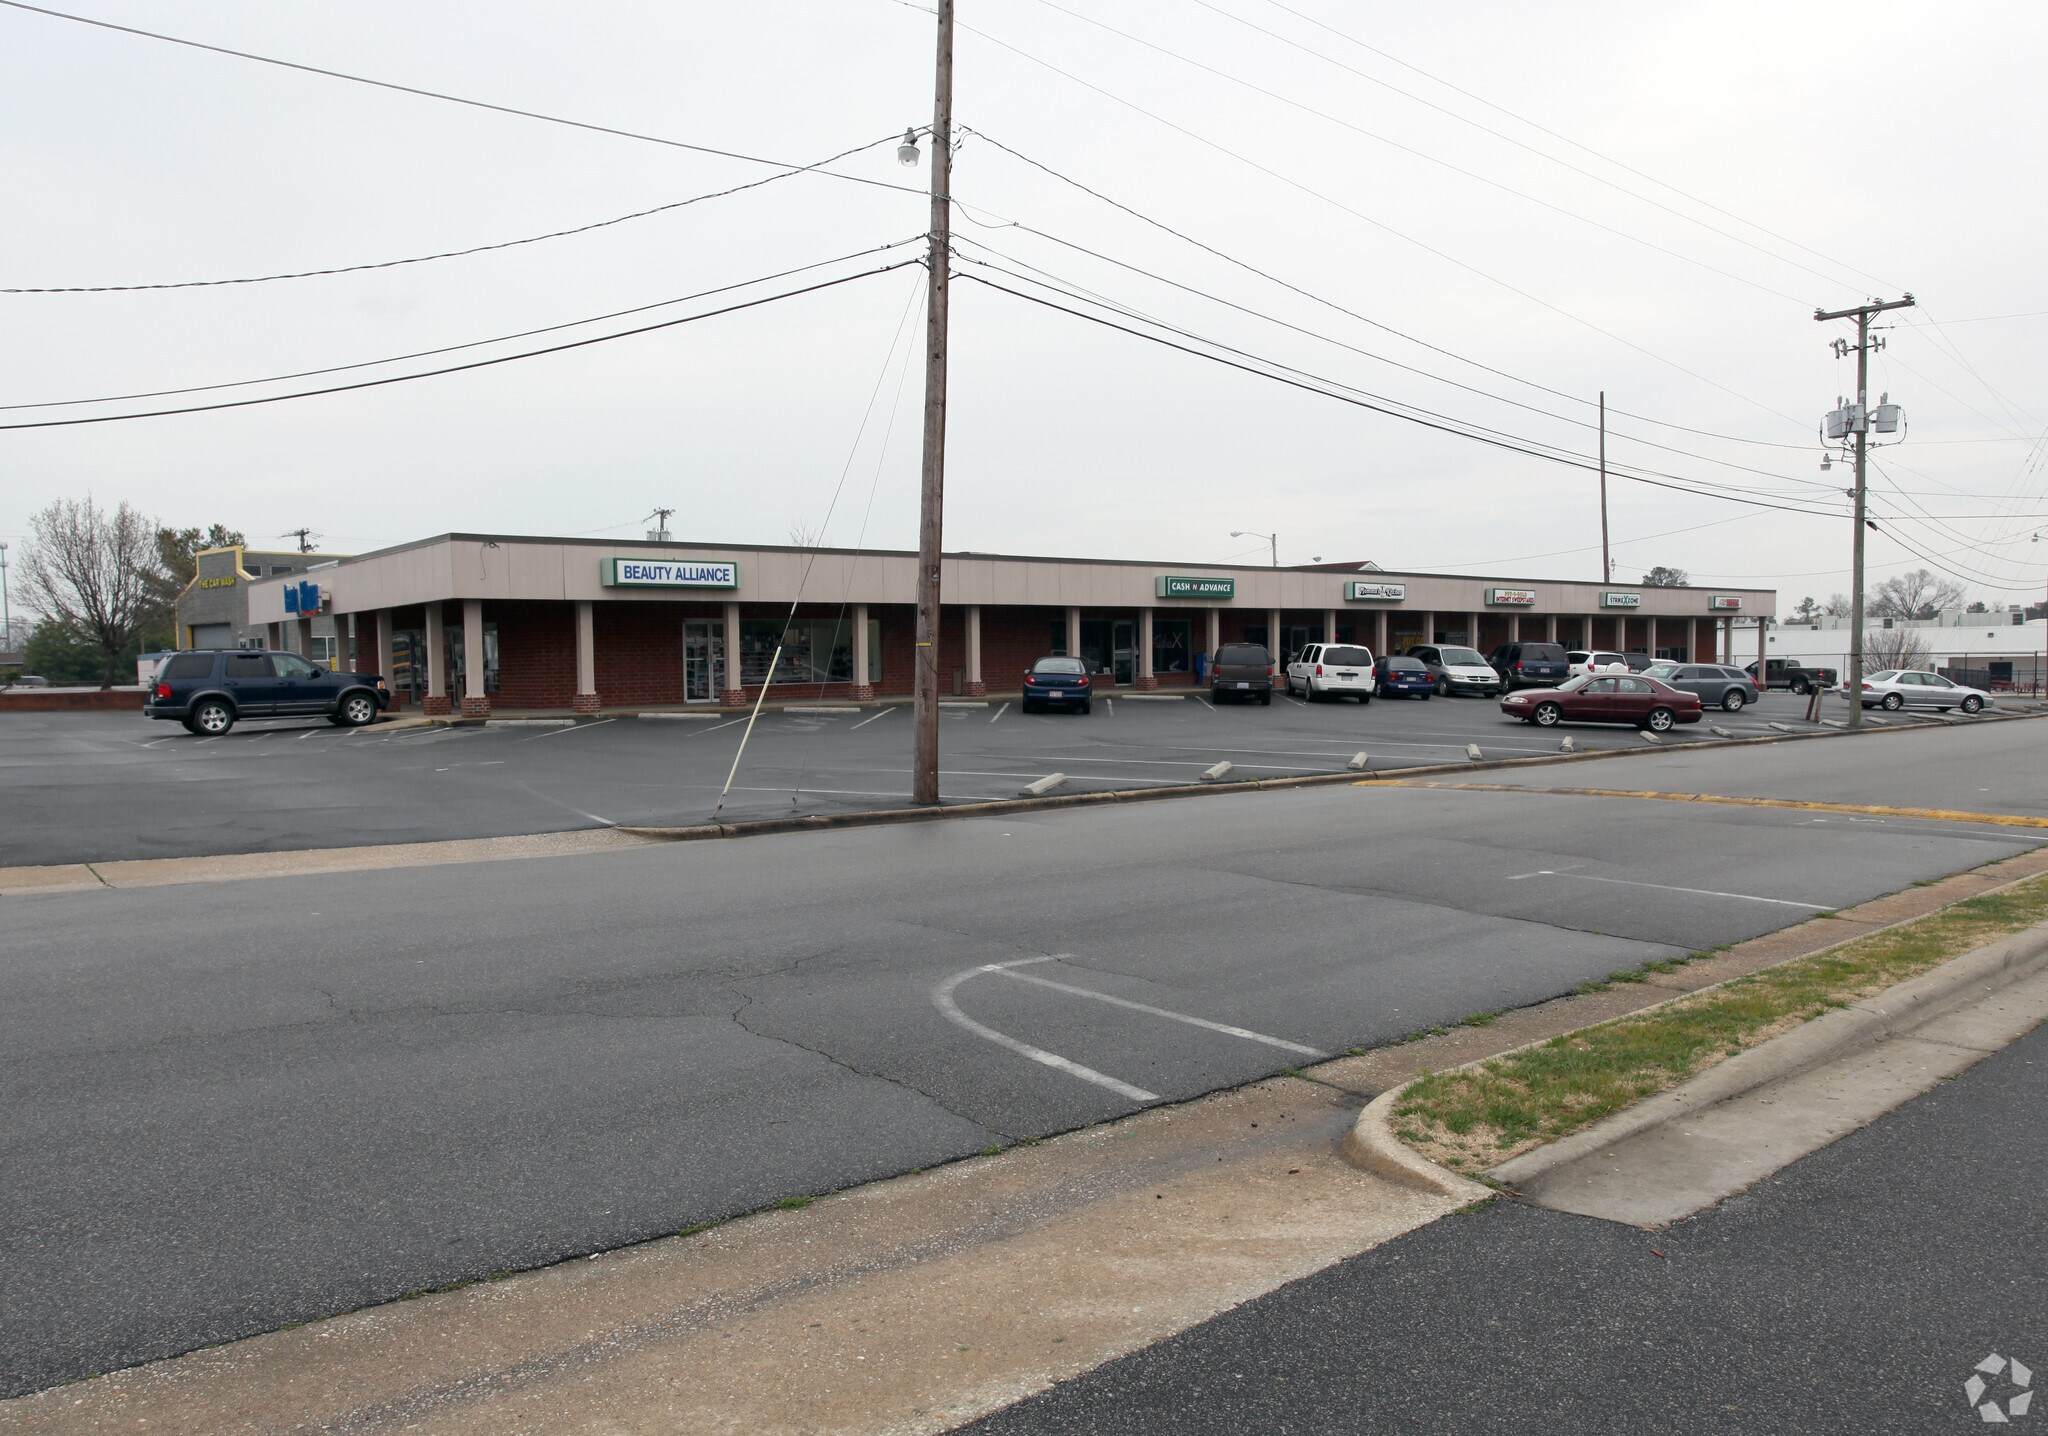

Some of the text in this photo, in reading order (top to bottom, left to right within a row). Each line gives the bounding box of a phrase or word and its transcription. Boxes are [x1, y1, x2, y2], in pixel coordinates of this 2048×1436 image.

[624, 565, 730, 582] BEAUTY ALLIANCE
[210, 578, 220, 588] CAR
[221, 577, 236, 587] WASH
[1171, 582, 1190, 591] CASH
[1199, 583, 1231, 592] ADVANCE
